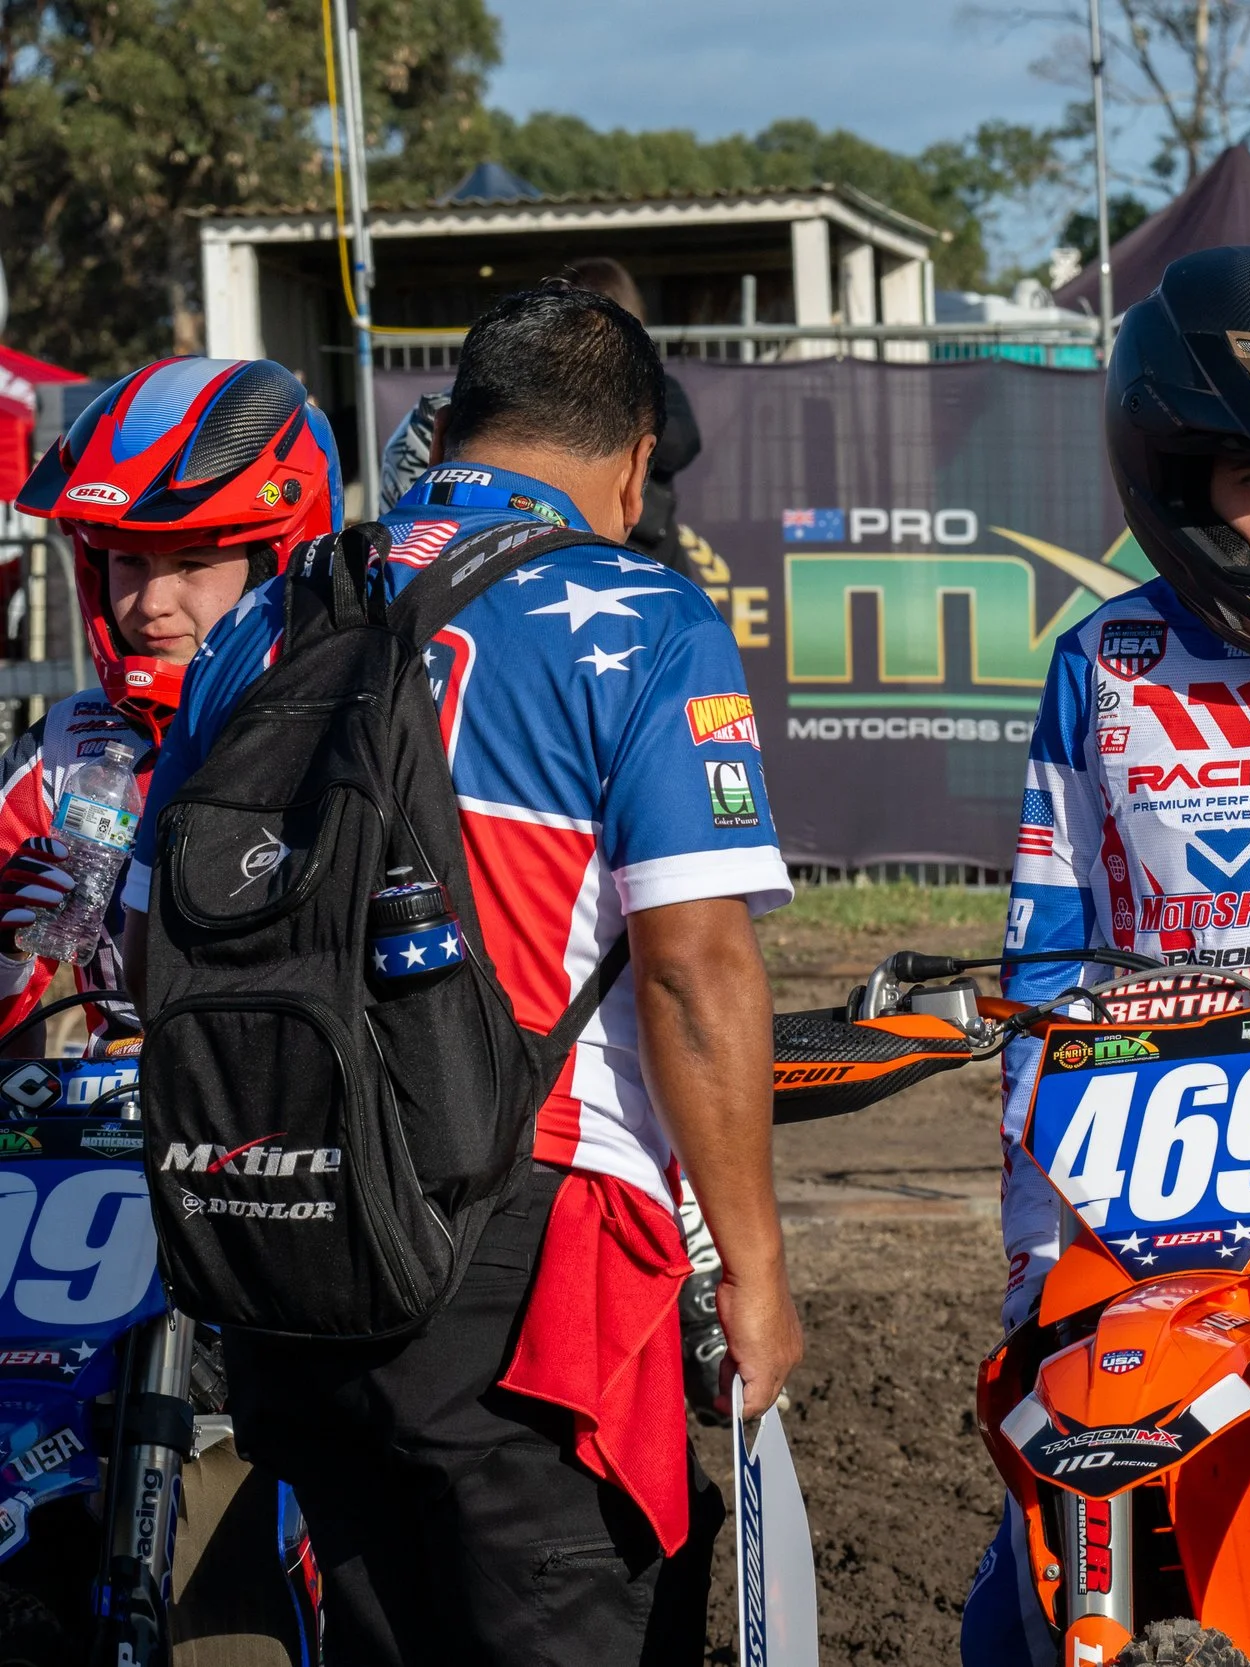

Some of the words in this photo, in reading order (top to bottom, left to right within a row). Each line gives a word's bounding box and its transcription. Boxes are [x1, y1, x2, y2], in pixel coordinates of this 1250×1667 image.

[425, 469, 492, 487] USA
[75, 488, 118, 501] BELL
[850, 508, 978, 544] PRO
[1103, 637, 1160, 657] USA
[129, 675, 148, 683] BELL
[713, 725, 735, 740] TAKE
[788, 717, 1000, 741] MOTOCROSS
[1133, 798, 1200, 812] PREMIUM
[714, 817, 733, 826] Coker
[735, 816, 759, 826] Pump
[1053, 1047, 1094, 1060] PENRITE
[80, 1137, 144, 1149] MOTOCROSS
[207, 1197, 337, 1221] DUNLOP
[1153, 1230, 1224, 1247] USA
[1102, 1356, 1141, 1368] USA
[10, 1427, 85, 1482] USA
[1053, 1451, 1116, 1477] 110
[1112, 1460, 1159, 1468] RACING
[1086, 1499, 1113, 1596] DR
